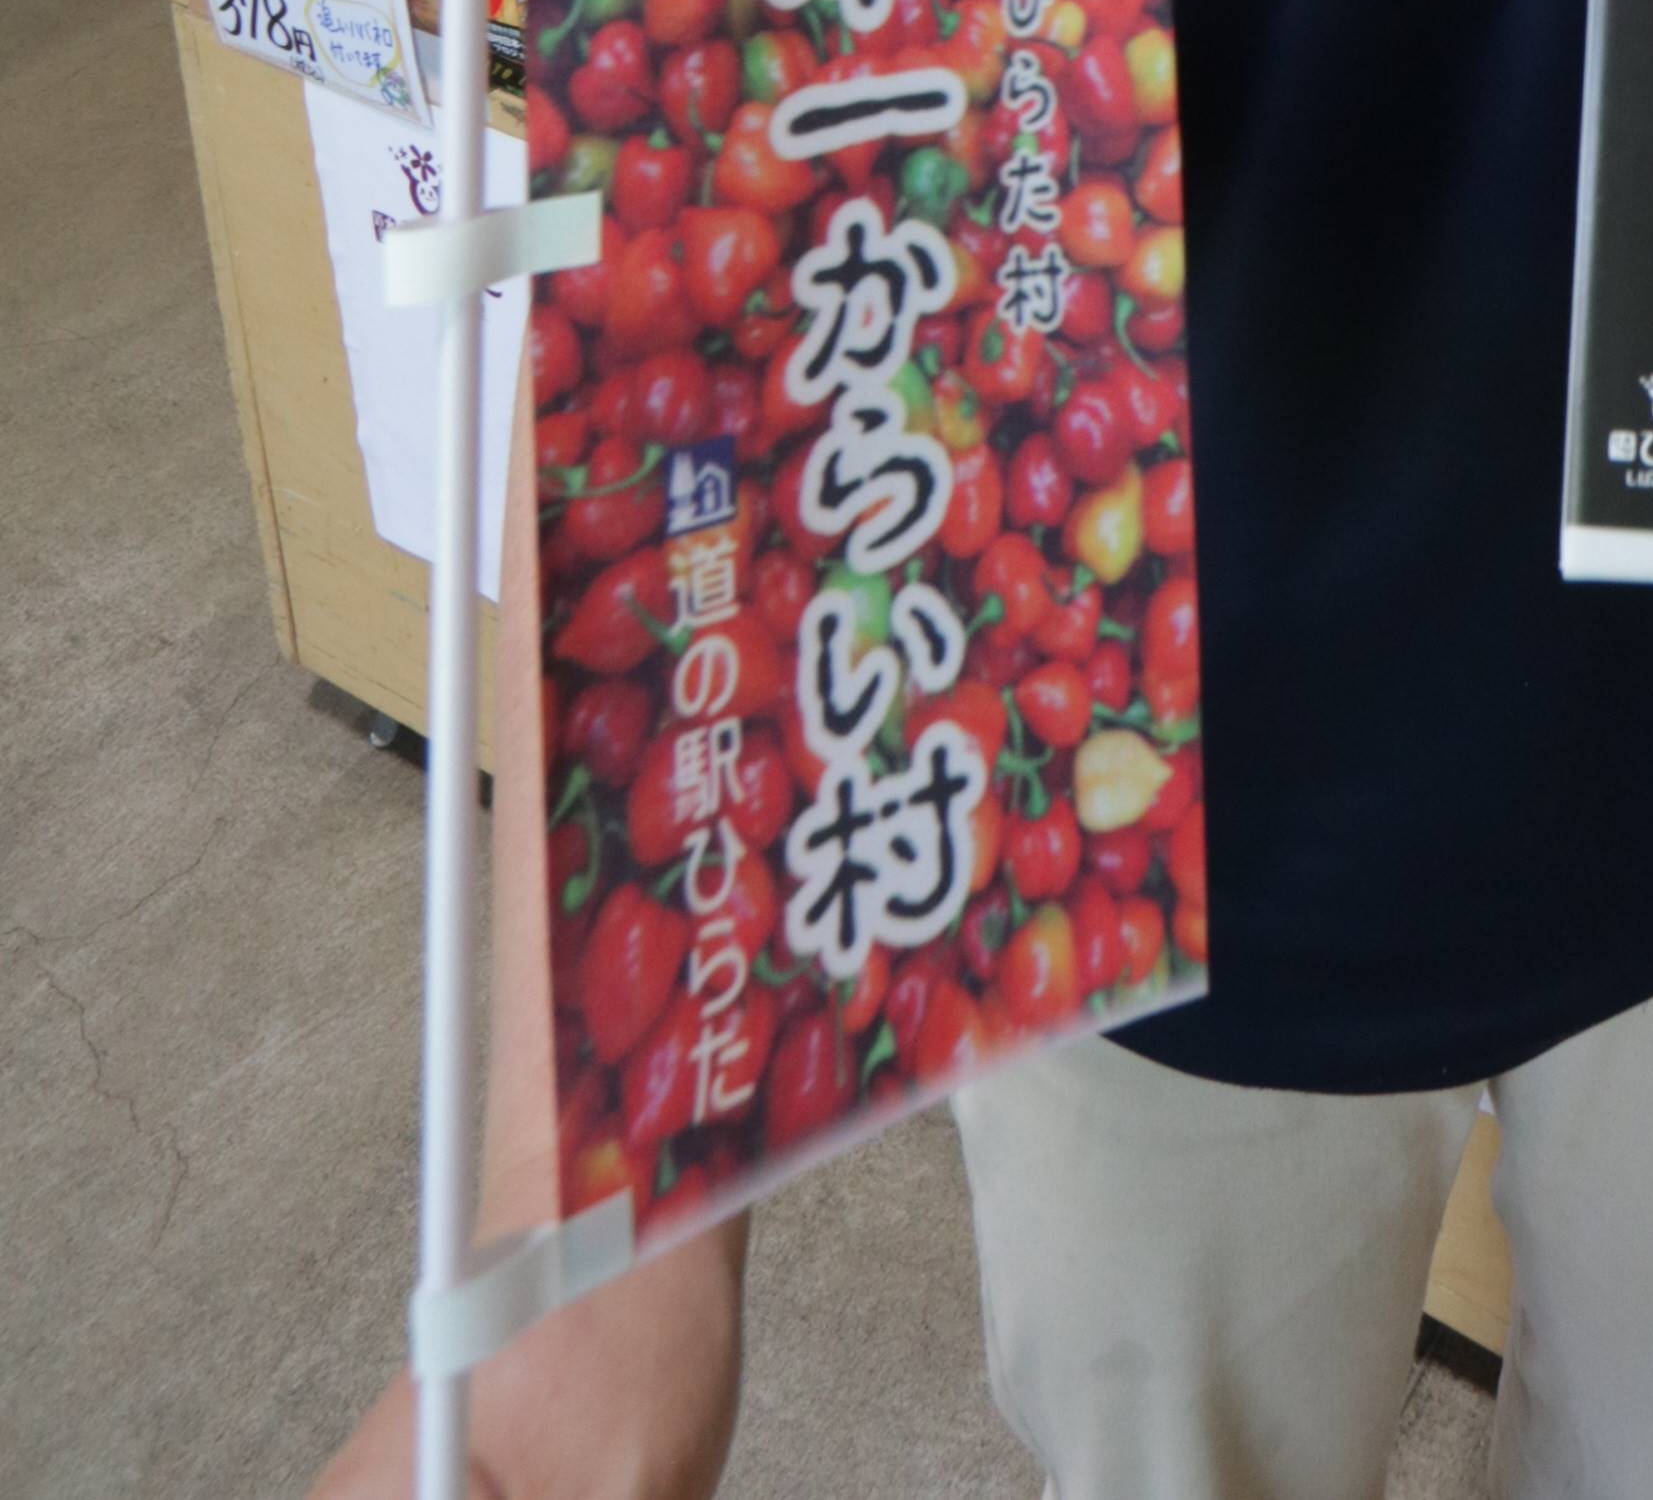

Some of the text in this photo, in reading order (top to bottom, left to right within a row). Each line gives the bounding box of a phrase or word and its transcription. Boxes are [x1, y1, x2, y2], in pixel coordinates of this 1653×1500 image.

[667, 537, 755, 1127] 道の駅ひらた
